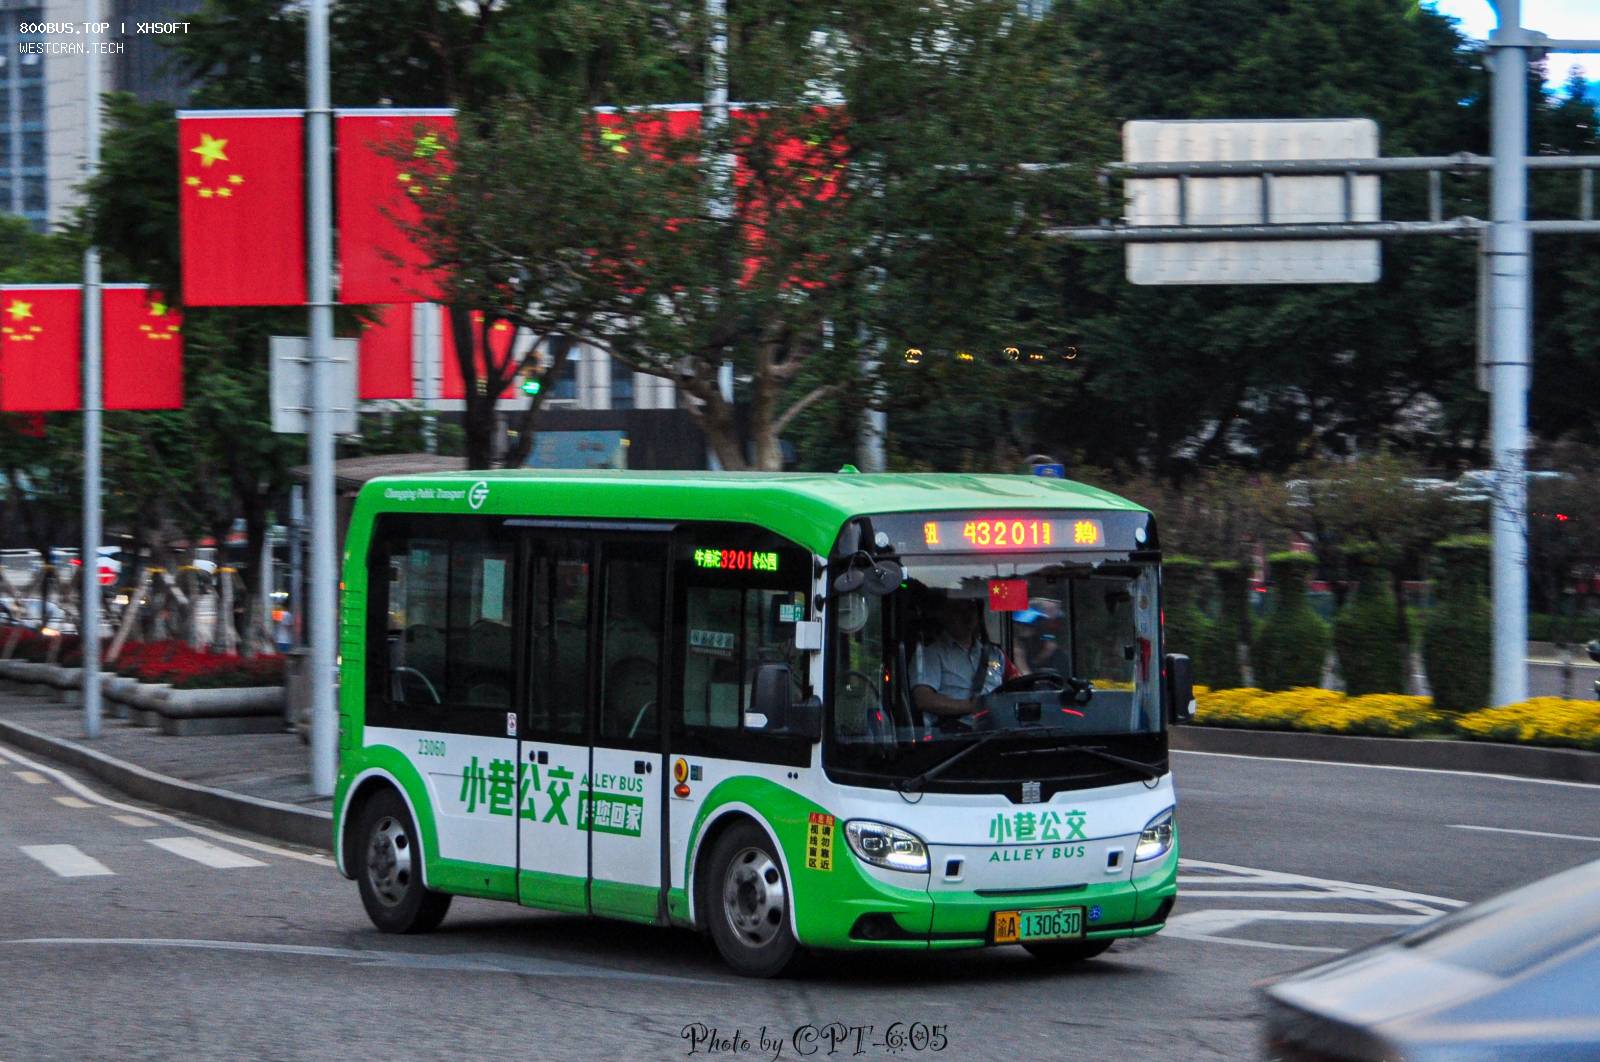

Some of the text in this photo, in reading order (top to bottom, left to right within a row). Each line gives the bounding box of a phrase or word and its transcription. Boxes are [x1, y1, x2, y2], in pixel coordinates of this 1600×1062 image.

[460, 756, 574, 825] 小巷公交
[619, 776, 643, 792] BUS
[989, 810, 1088, 842] 小巷公交
[989, 846, 1085, 862] ALLEY BUS
